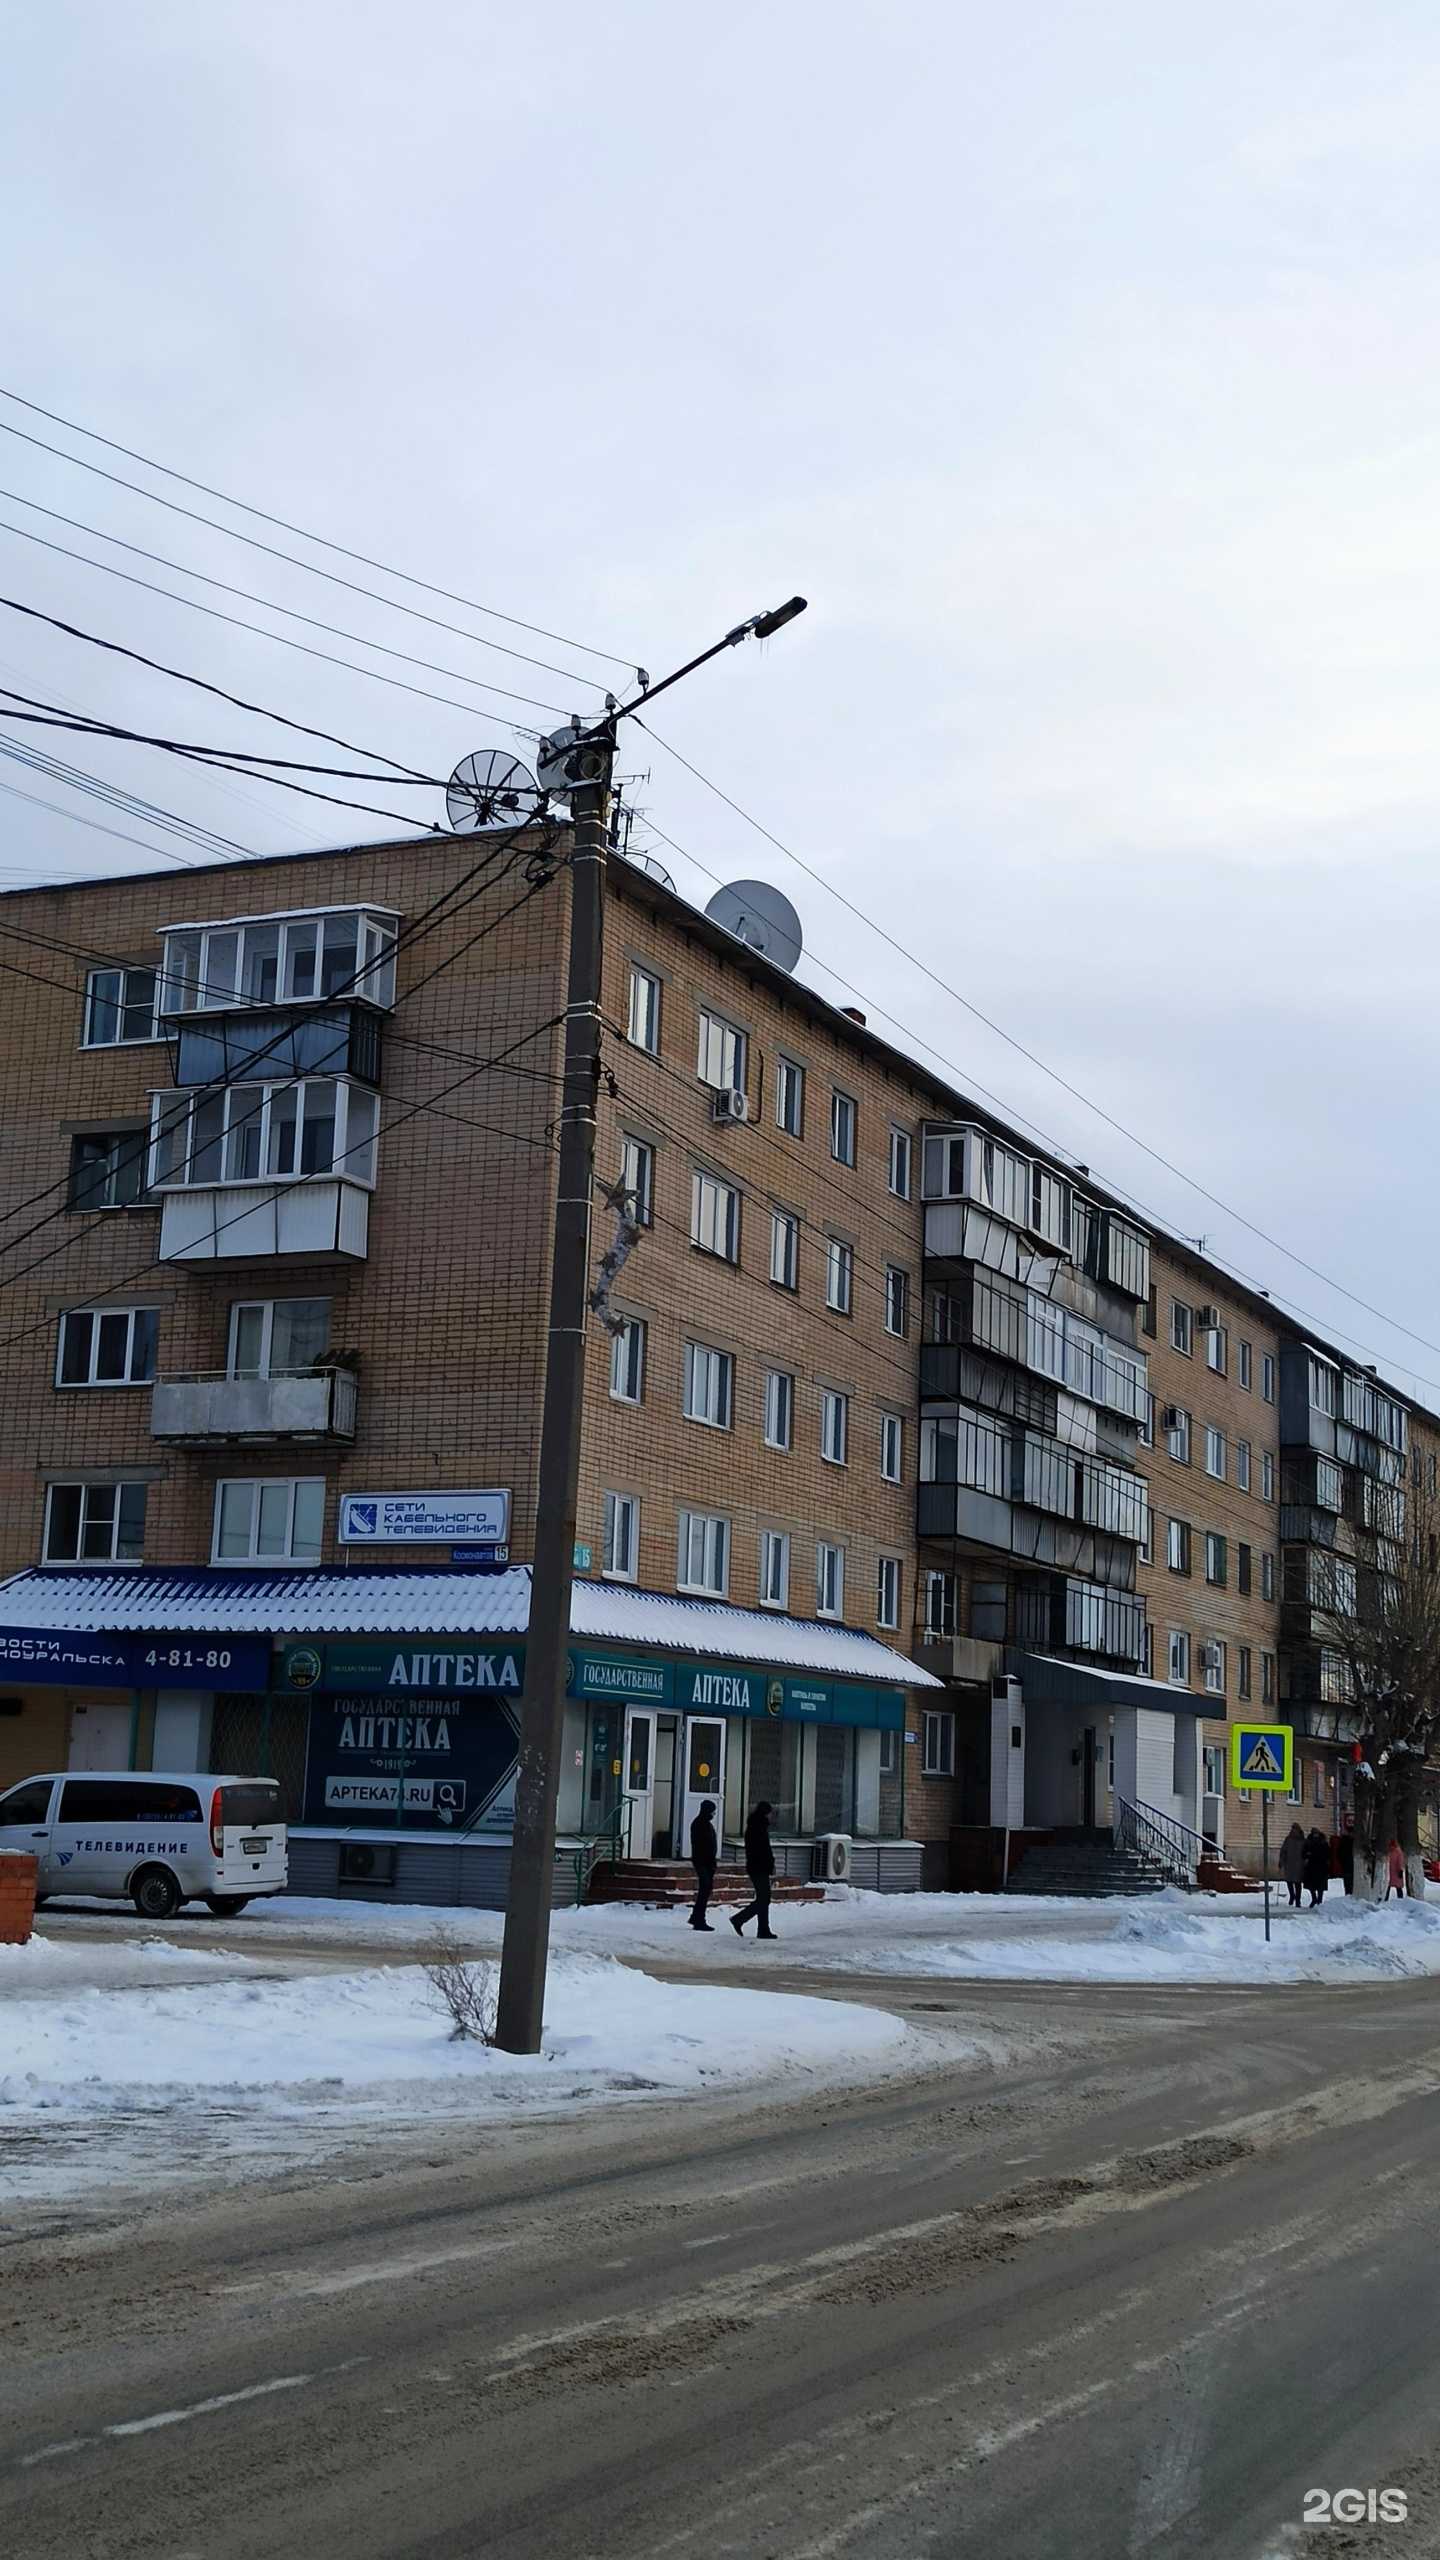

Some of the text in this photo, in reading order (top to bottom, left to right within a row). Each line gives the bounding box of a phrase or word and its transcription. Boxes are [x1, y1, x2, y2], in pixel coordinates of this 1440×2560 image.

[384, 1502, 425, 1512] СЕТИ
[384, 1513, 487, 1523] КАБЕЛЬНОГО
[384, 1524, 497, 1534] ТЕЛЕВИДЕНИЯ
[497, 1547, 507, 1560] 15
[145, 1650, 232, 1668] 4-81-80
[388, 1653, 520, 1687] АПТЕКА
[583, 1664, 750, 1708] ГОСУДАРСТВЕННАЯ АПТЕКА
[333, 1698, 461, 1716] ГОСУДАРСВЕННАЯ
[338, 1716, 451, 1750] АПТЕКА
[330, 1786, 431, 1802] APTEKA7.RU
[76, 1840, 189, 1855] ТЕЛЕВИДЕНИЕ
